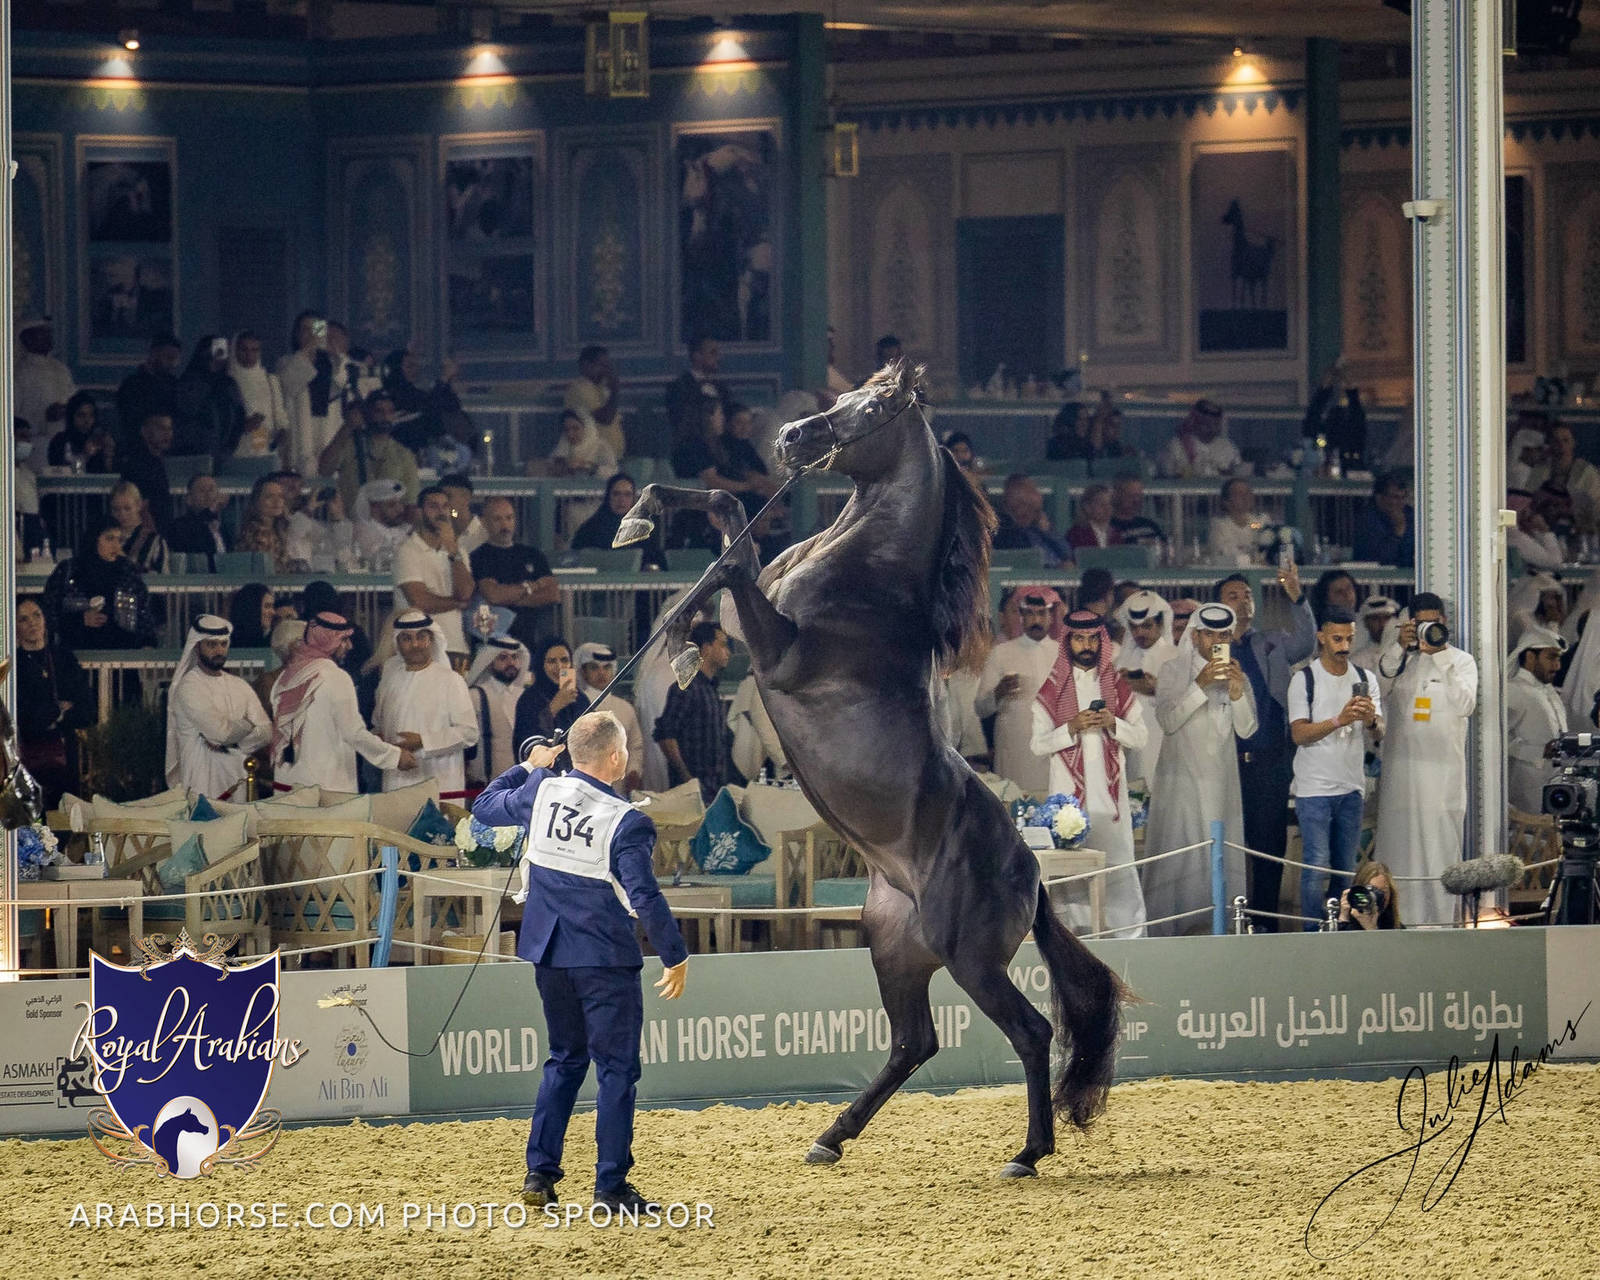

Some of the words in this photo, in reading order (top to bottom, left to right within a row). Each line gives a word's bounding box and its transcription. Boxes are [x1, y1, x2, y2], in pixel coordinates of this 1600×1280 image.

[546, 801, 594, 848] 134
[25, 1008, 39, 1019] Gold
[39, 1008, 63, 1021] Sponsor
[1176, 996, 1266, 1050] العربية
[1276, 994, 1348, 1048] للخيل
[1357, 991, 1434, 1045] العالم
[1443, 990, 1523, 1041] بطولة
[438, 1027, 539, 1076] WORLD
[677, 1013, 768, 1063] HORSE
[774, 1005, 971, 1058] CHAMPIOHIP
[2, 1062, 55, 1080] ASMAKH
[319, 1079, 337, 1101] Ali
[341, 1078, 365, 1100] Bin
[369, 1075, 388, 1098] Ali
